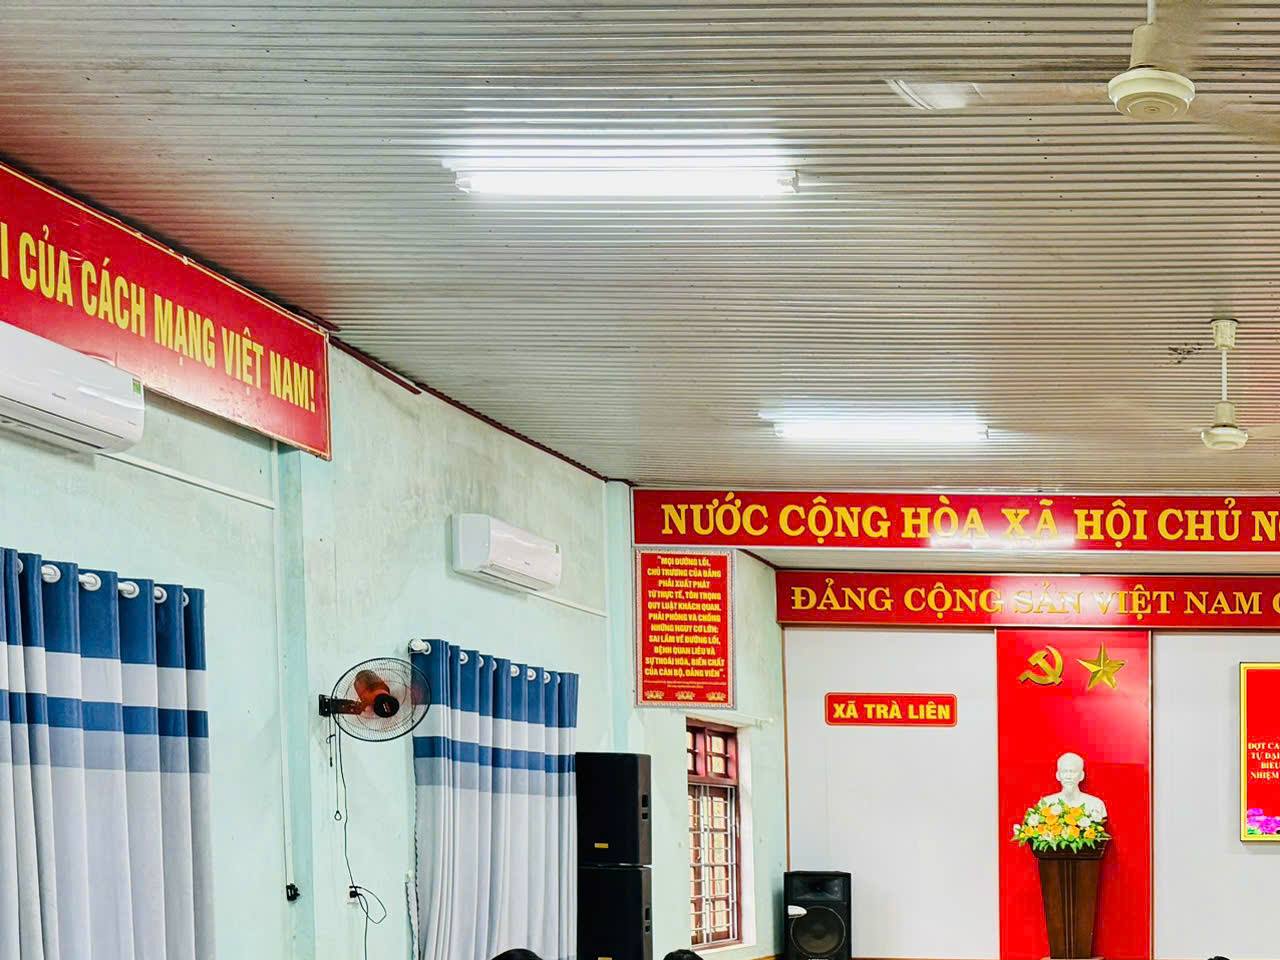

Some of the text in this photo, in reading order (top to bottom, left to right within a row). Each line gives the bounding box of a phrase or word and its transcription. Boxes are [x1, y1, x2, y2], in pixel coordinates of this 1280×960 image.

[19, 224, 74, 307] CỦA
[81, 256, 146, 338] CÁCH
[153, 294, 216, 369] MẠNG
[221, 326, 264, 396] VIỆT
[269, 350, 316, 413] NAM!
[661, 492, 769, 536] NƯỚC
[778, 495, 891, 545] CỘNG
[900, 496, 991, 539] HÒA
[1001, 499, 1062, 541] XÃ
[1074, 500, 1148, 548] HỘI
[1157, 498, 1243, 541] CHỦ
[791, 577, 892, 612] ĐẢNG
[903, 583, 1004, 620] CỘNG
[1013, 580, 1081, 614] SẢN
[1094, 583, 1175, 620] VIỆT
[1184, 591, 1262, 614] NAM
[833, 700, 951, 720] XÃ TRÀ LIÊN
